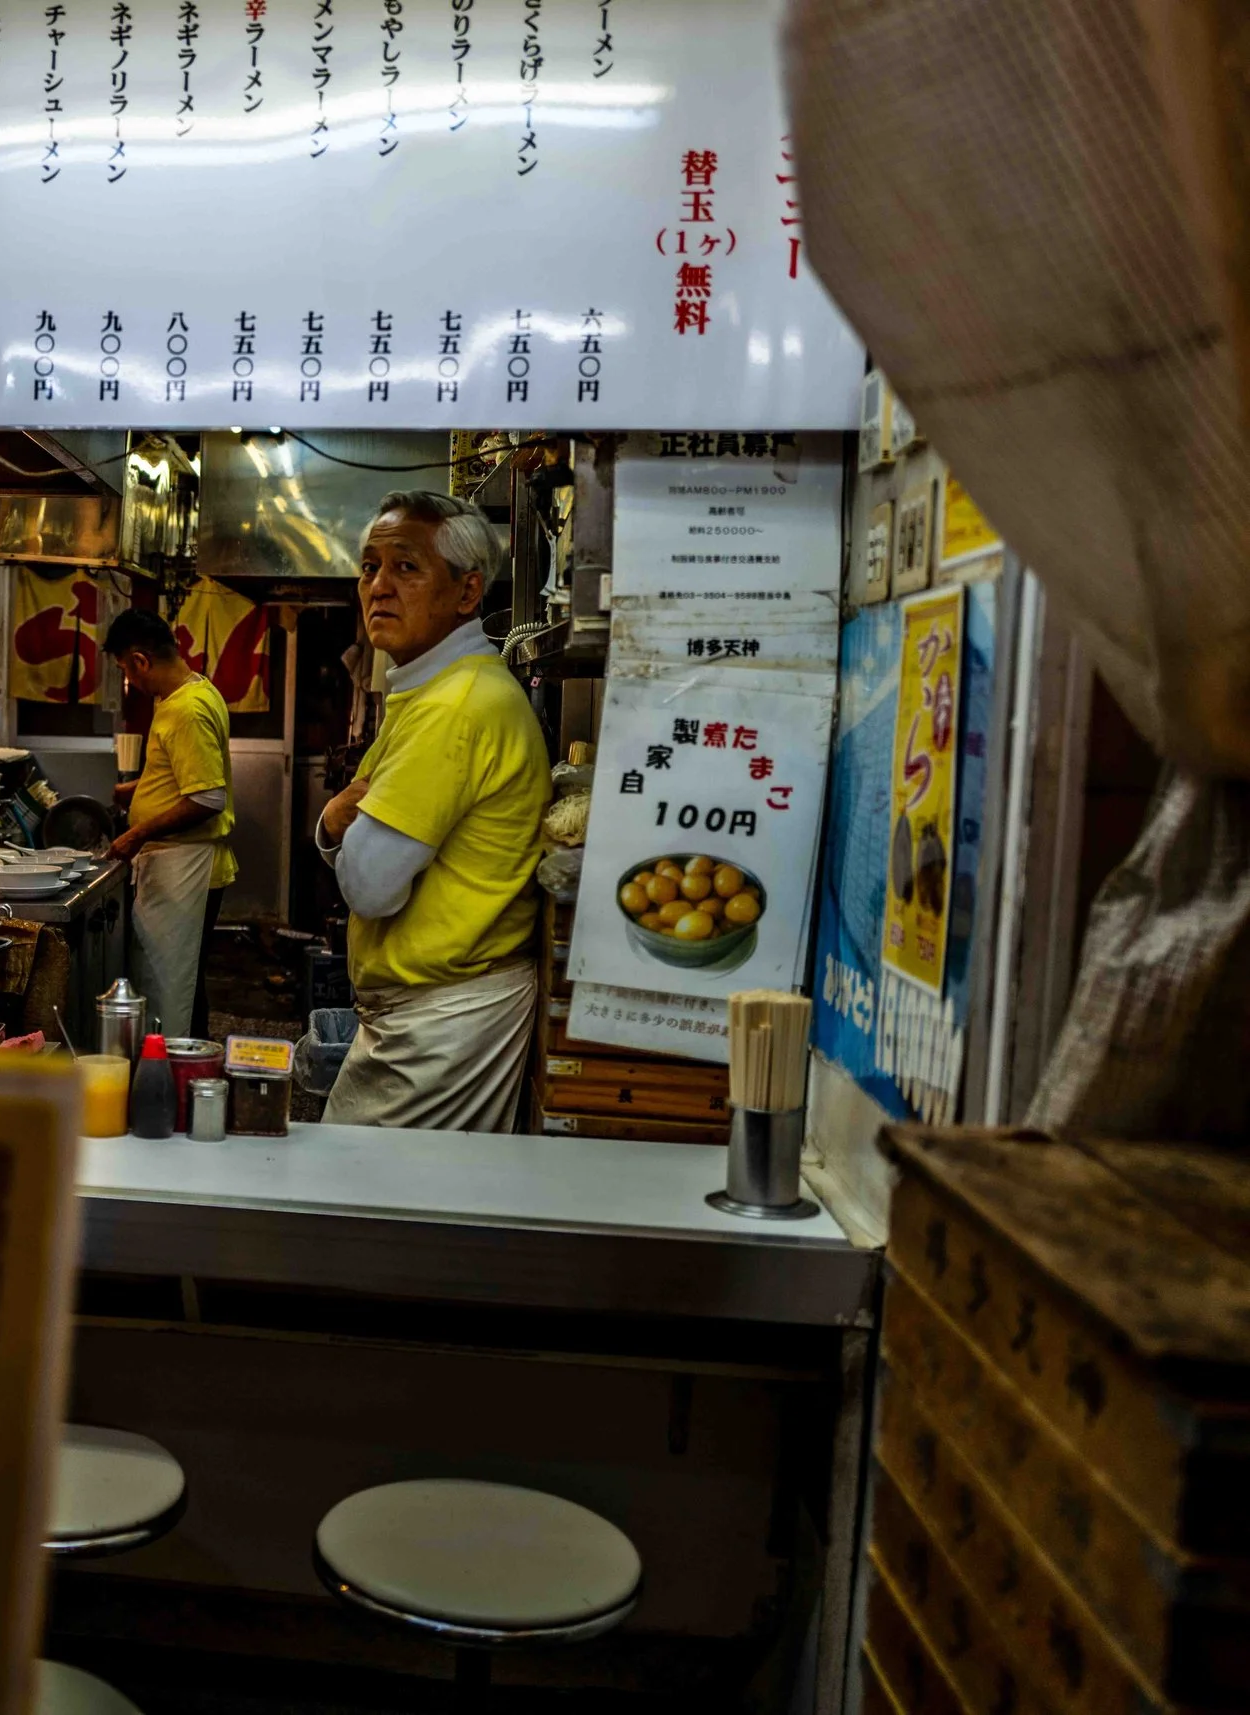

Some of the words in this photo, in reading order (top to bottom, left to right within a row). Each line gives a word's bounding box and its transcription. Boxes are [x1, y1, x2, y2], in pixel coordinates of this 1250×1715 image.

[41, 4, 66, 184] チャーシューメン
[107, 2, 132, 183] ネギノリラーメン
[176, 1, 200, 137] ネギラーメン
[310, 0, 334, 158] メンマラーメン
[379, 0, 404, 157] もやしラーメン
[686, 638, 760, 657] 博多天神
[655, 801, 757, 837] 100円
